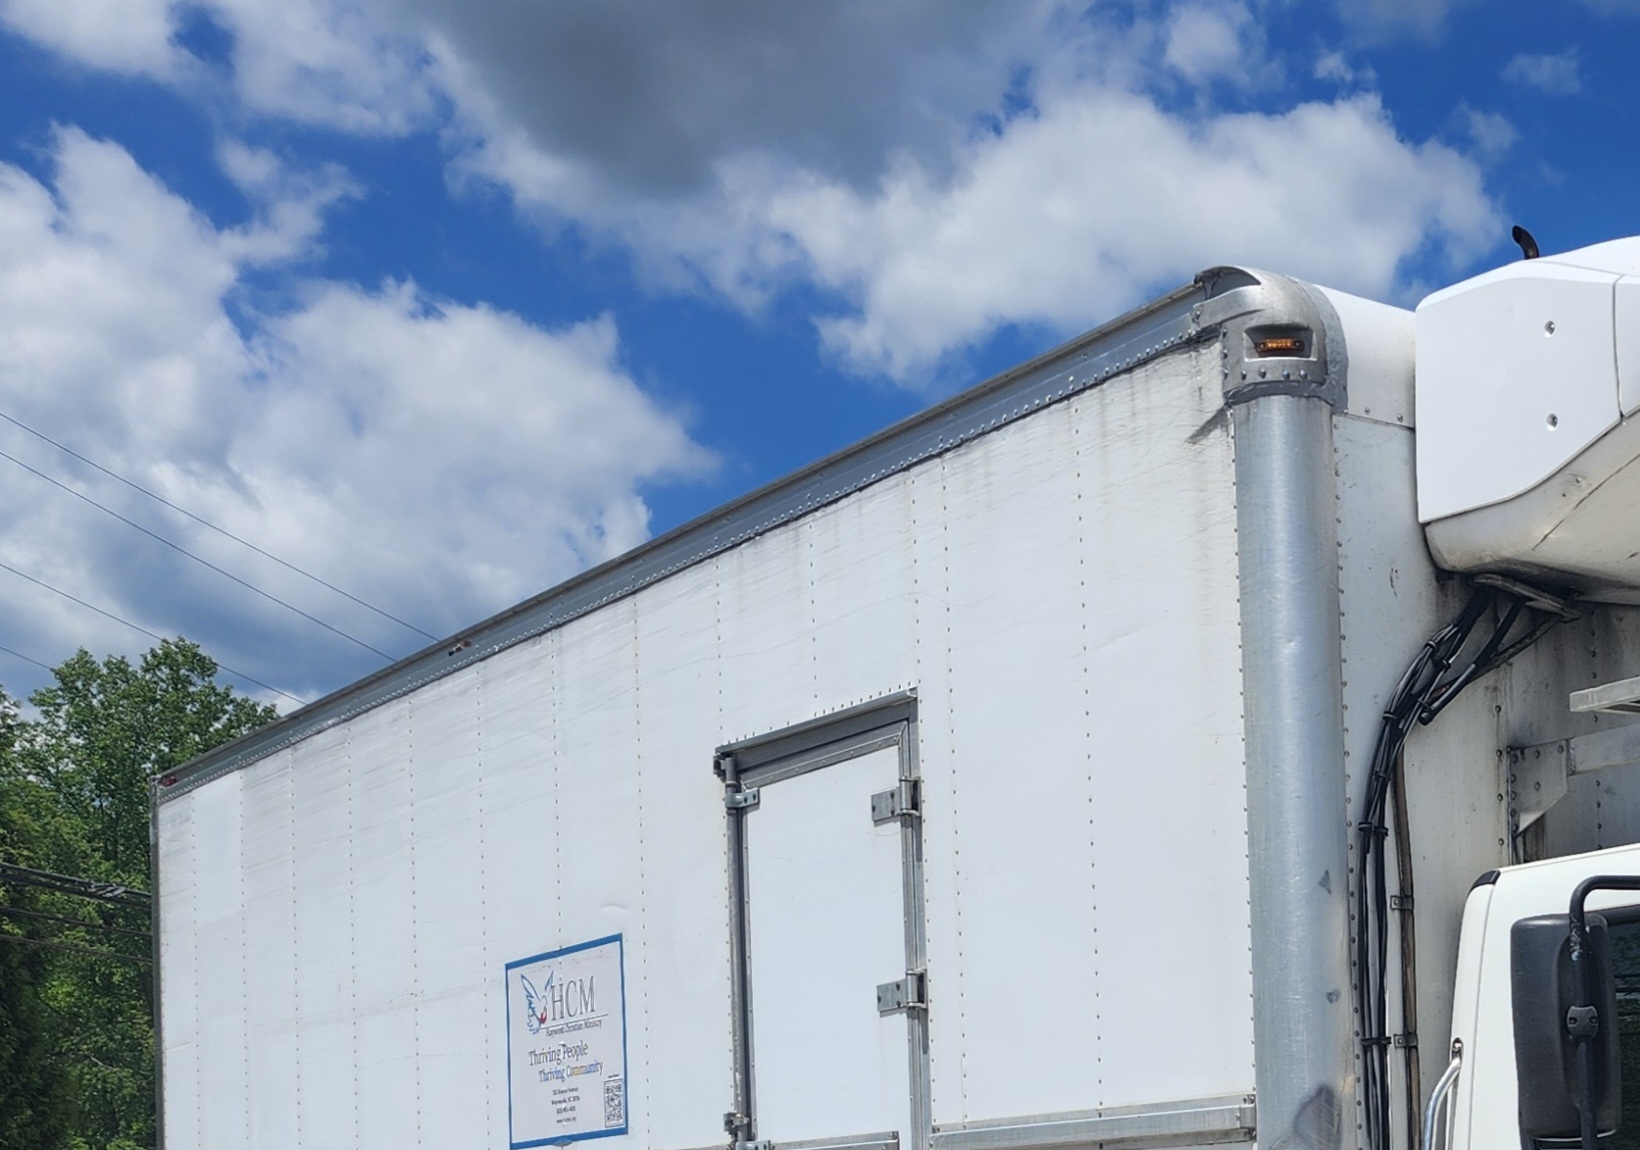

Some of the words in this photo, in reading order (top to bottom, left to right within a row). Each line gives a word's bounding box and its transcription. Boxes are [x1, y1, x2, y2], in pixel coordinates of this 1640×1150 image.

[550, 975, 596, 1021] HCM
[528, 1046, 561, 1066] Thriving
[560, 1039, 588, 1061] People
[539, 1066, 566, 1083] Thriving
[566, 1059, 604, 1078] Community
